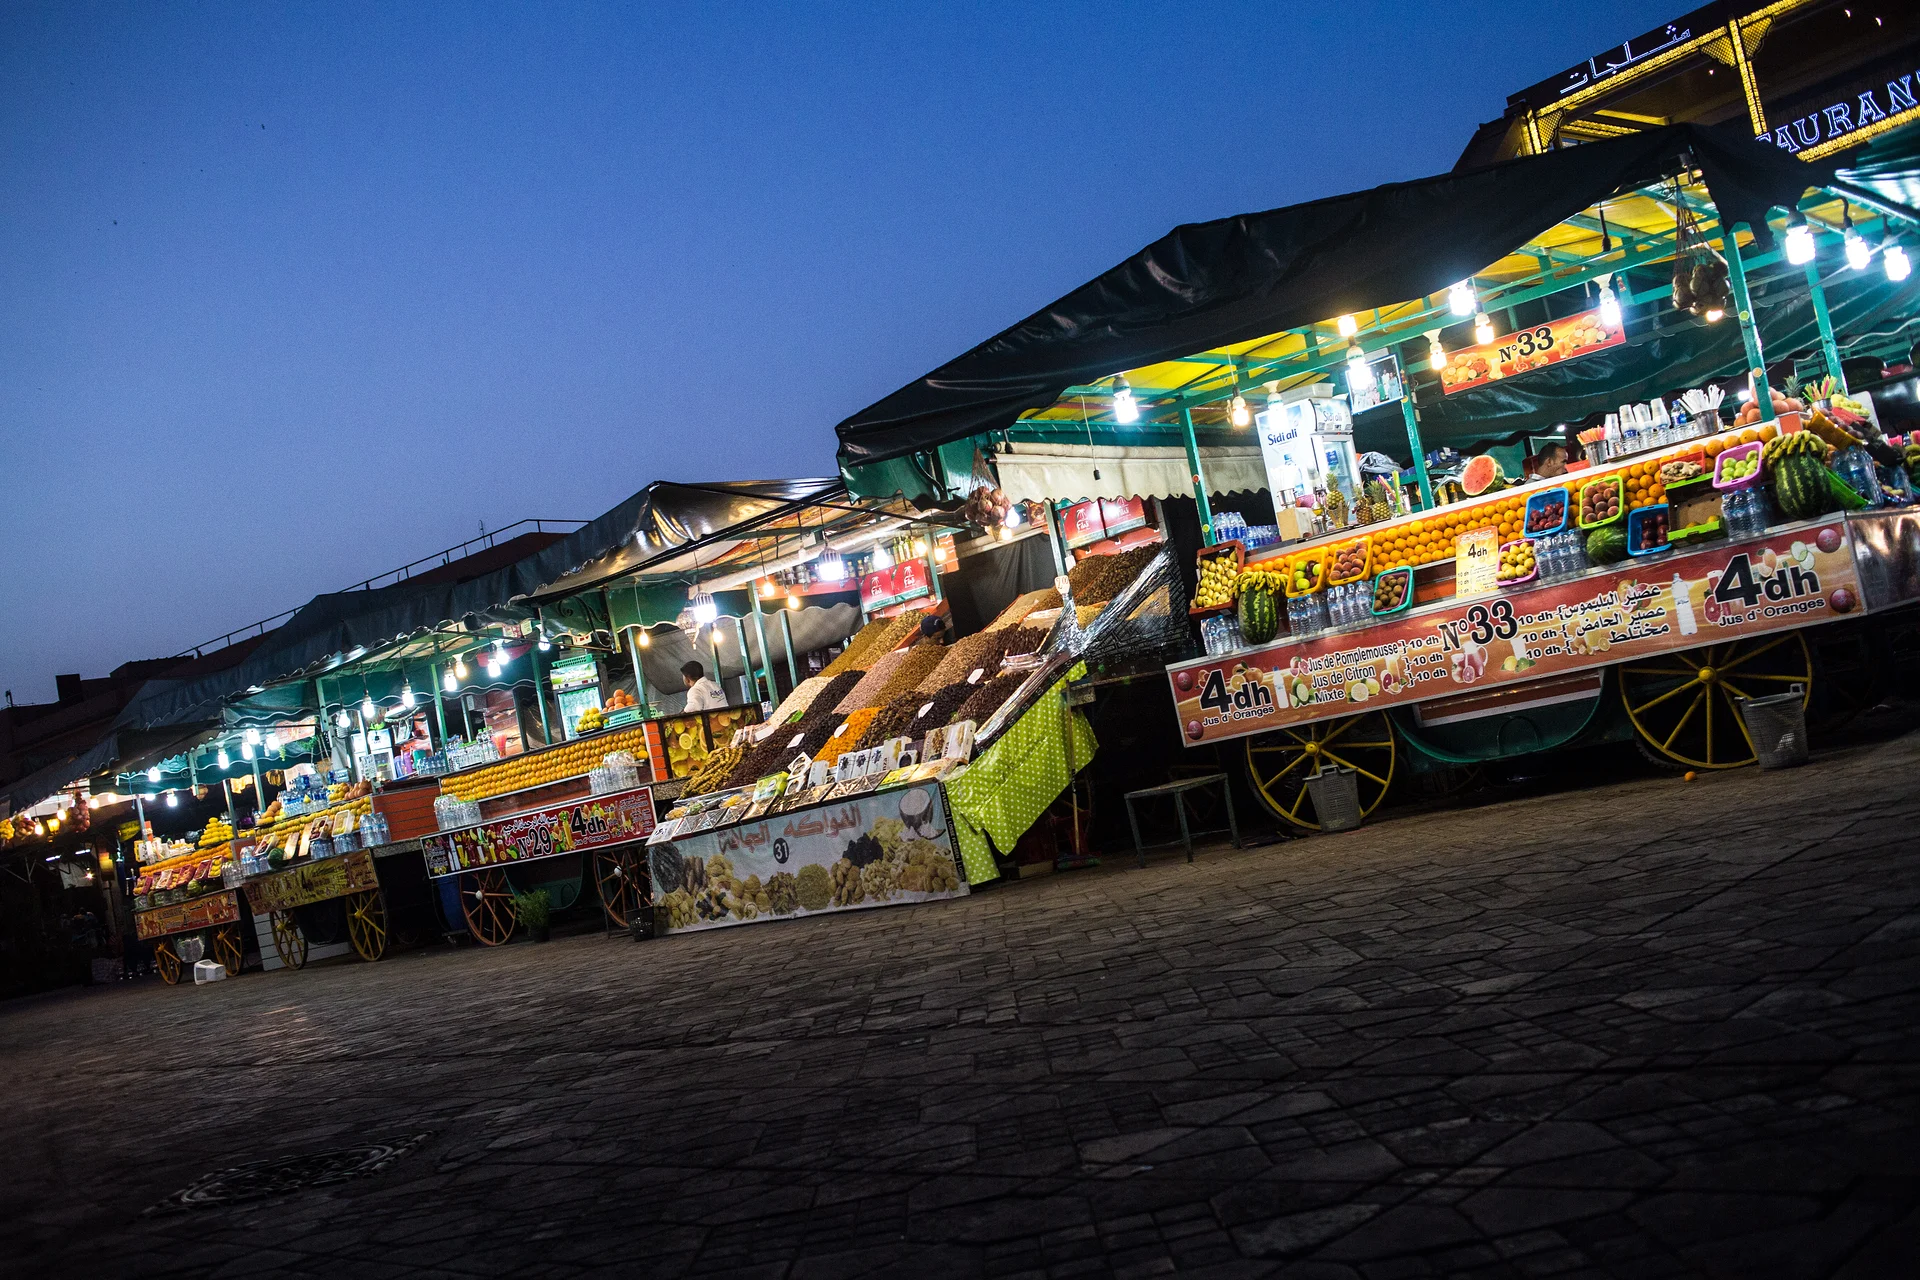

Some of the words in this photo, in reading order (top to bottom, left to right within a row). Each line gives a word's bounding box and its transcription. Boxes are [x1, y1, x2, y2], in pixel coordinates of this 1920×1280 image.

[1560, 24, 1691, 94] مثلجات
[1754, 70, 1920, 153] AURAN
[1267, 429, 1286, 446] Sidi
[1286, 428, 1298, 441] ali
[1468, 543, 1488, 558] 4dh
[1714, 553, 1821, 607] 4dh
[1624, 586, 1661, 605] عصير
[1519, 615, 1534, 625] 10
[1537, 612, 1553, 622] dh
[1577, 611, 1623, 637] الحامض
[1628, 607, 1666, 625] عصير
[1719, 615, 1743, 627] Jus
[1522, 632, 1538, 643] 10
[1541, 629, 1557, 640] dh
[1608, 623, 1669, 644] مختلط
[1308, 658, 1323, 672] Jus
[1324, 655, 1334, 669] de
[1336, 642, 1399, 666] Pomplemousse
[1409, 639, 1423, 649] 10
[1426, 636, 1439, 646] dh
[1526, 648, 1541, 659] 10
[1545, 645, 1561, 656] dh
[1312, 675, 1328, 689] Jus
[1330, 672, 1343, 685] de
[1344, 665, 1376, 682] Citron
[1413, 655, 1427, 666] 10
[1429, 653, 1443, 663] dh
[1200, 669, 1272, 713] 4dh
[1315, 688, 1345, 703] Mixte
[1416, 671, 1430, 681] 10
[1433, 668, 1447, 679] dh
[1203, 717, 1220, 727] Jus
[571, 806, 607, 836] 4dh
[783, 802, 862, 839] الفواكه
[775, 842, 788, 860] 31
